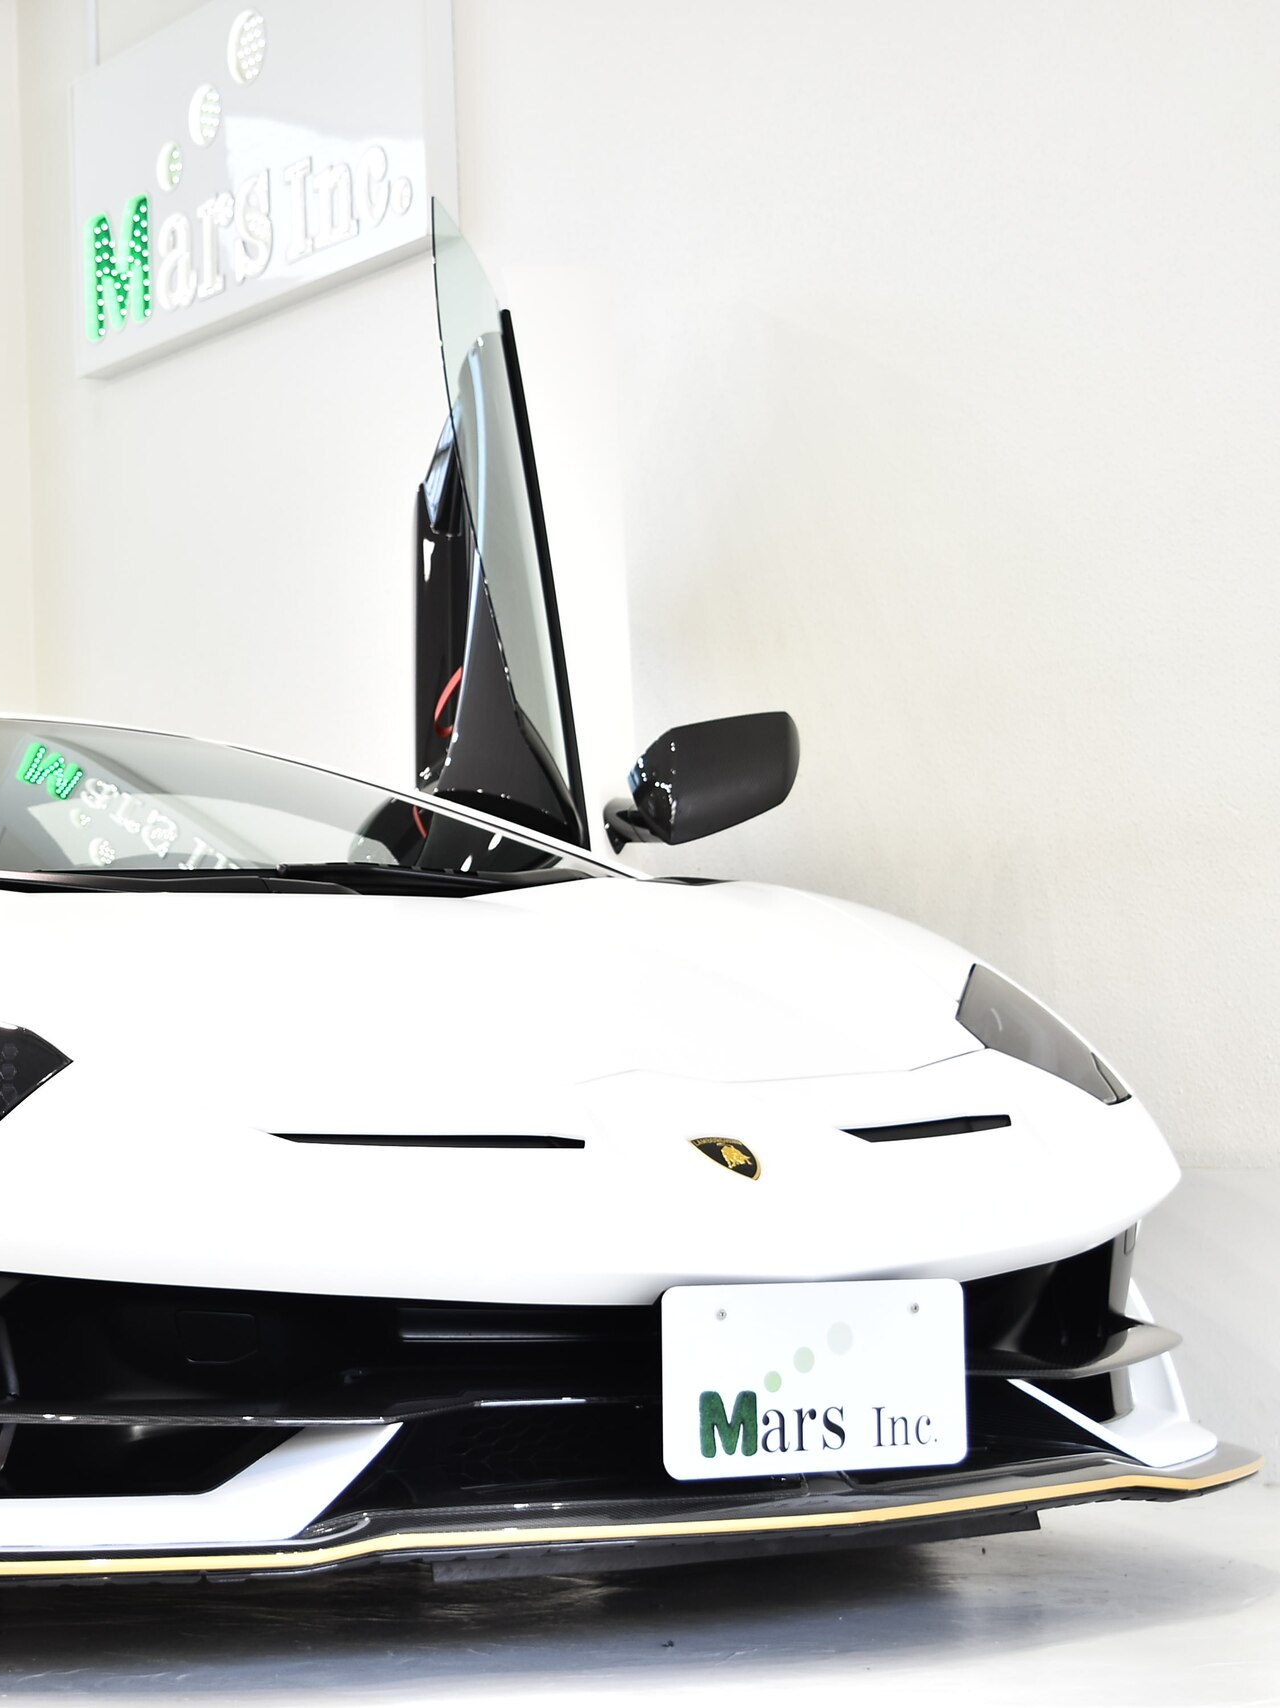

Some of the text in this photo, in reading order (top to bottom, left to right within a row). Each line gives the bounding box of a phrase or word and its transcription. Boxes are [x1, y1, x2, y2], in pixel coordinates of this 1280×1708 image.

[84, 145, 413, 342] Mars Inc.
[698, 1390, 938, 1458] Mars Inc.
